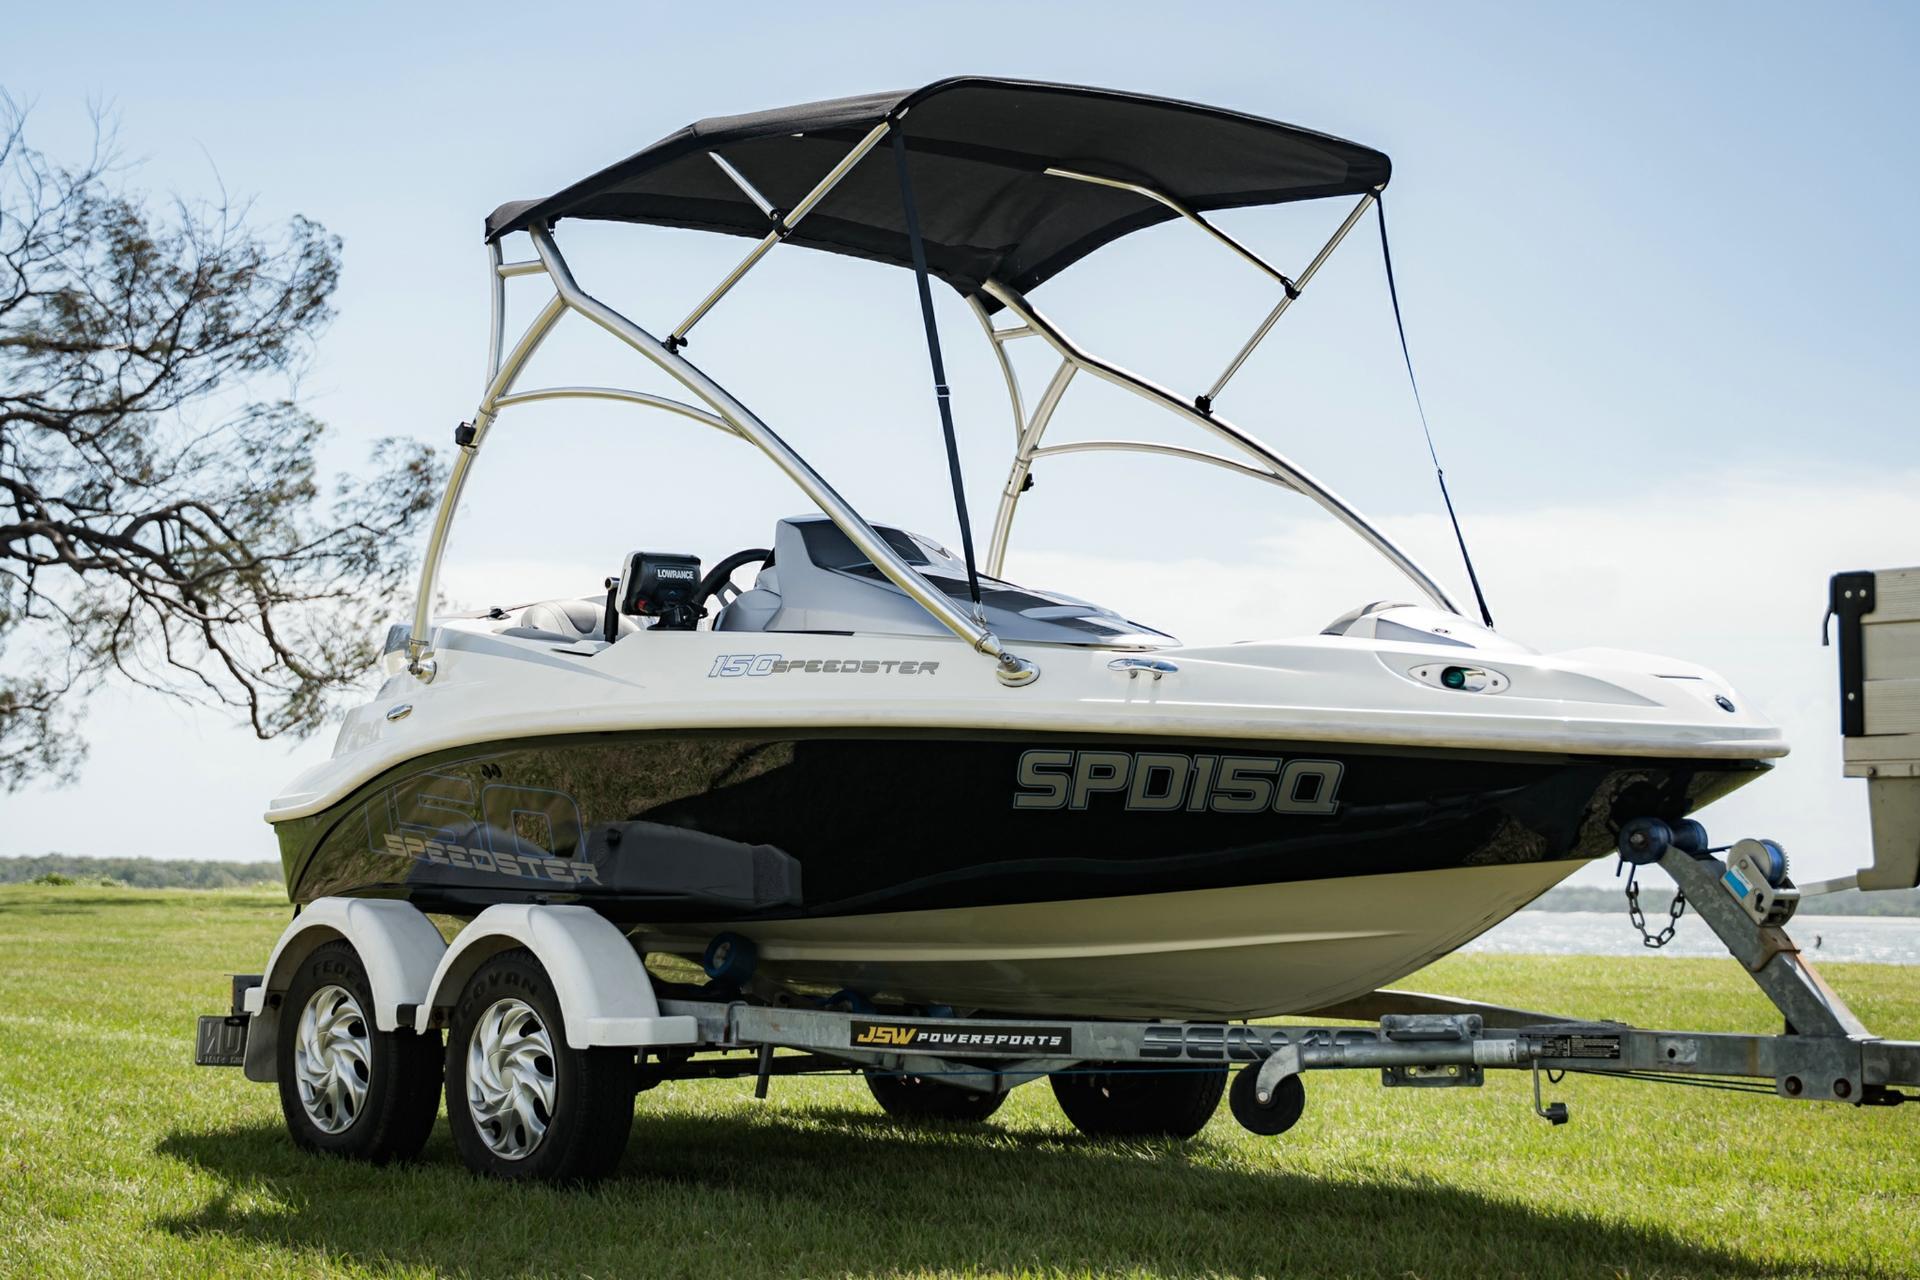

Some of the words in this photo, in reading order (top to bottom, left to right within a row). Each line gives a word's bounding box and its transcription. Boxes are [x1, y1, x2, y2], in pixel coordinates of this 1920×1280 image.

[657, 569, 694, 580] LOWRANCE
[708, 654, 782, 678] 150
[771, 660, 940, 676] SPEEDSTER
[1012, 749, 1345, 815] SPD15Q
[384, 833, 603, 886] SPEEDSTER
[857, 1026, 917, 1045] JSW
[917, 1032, 1062, 1046] POWERSPORTS
